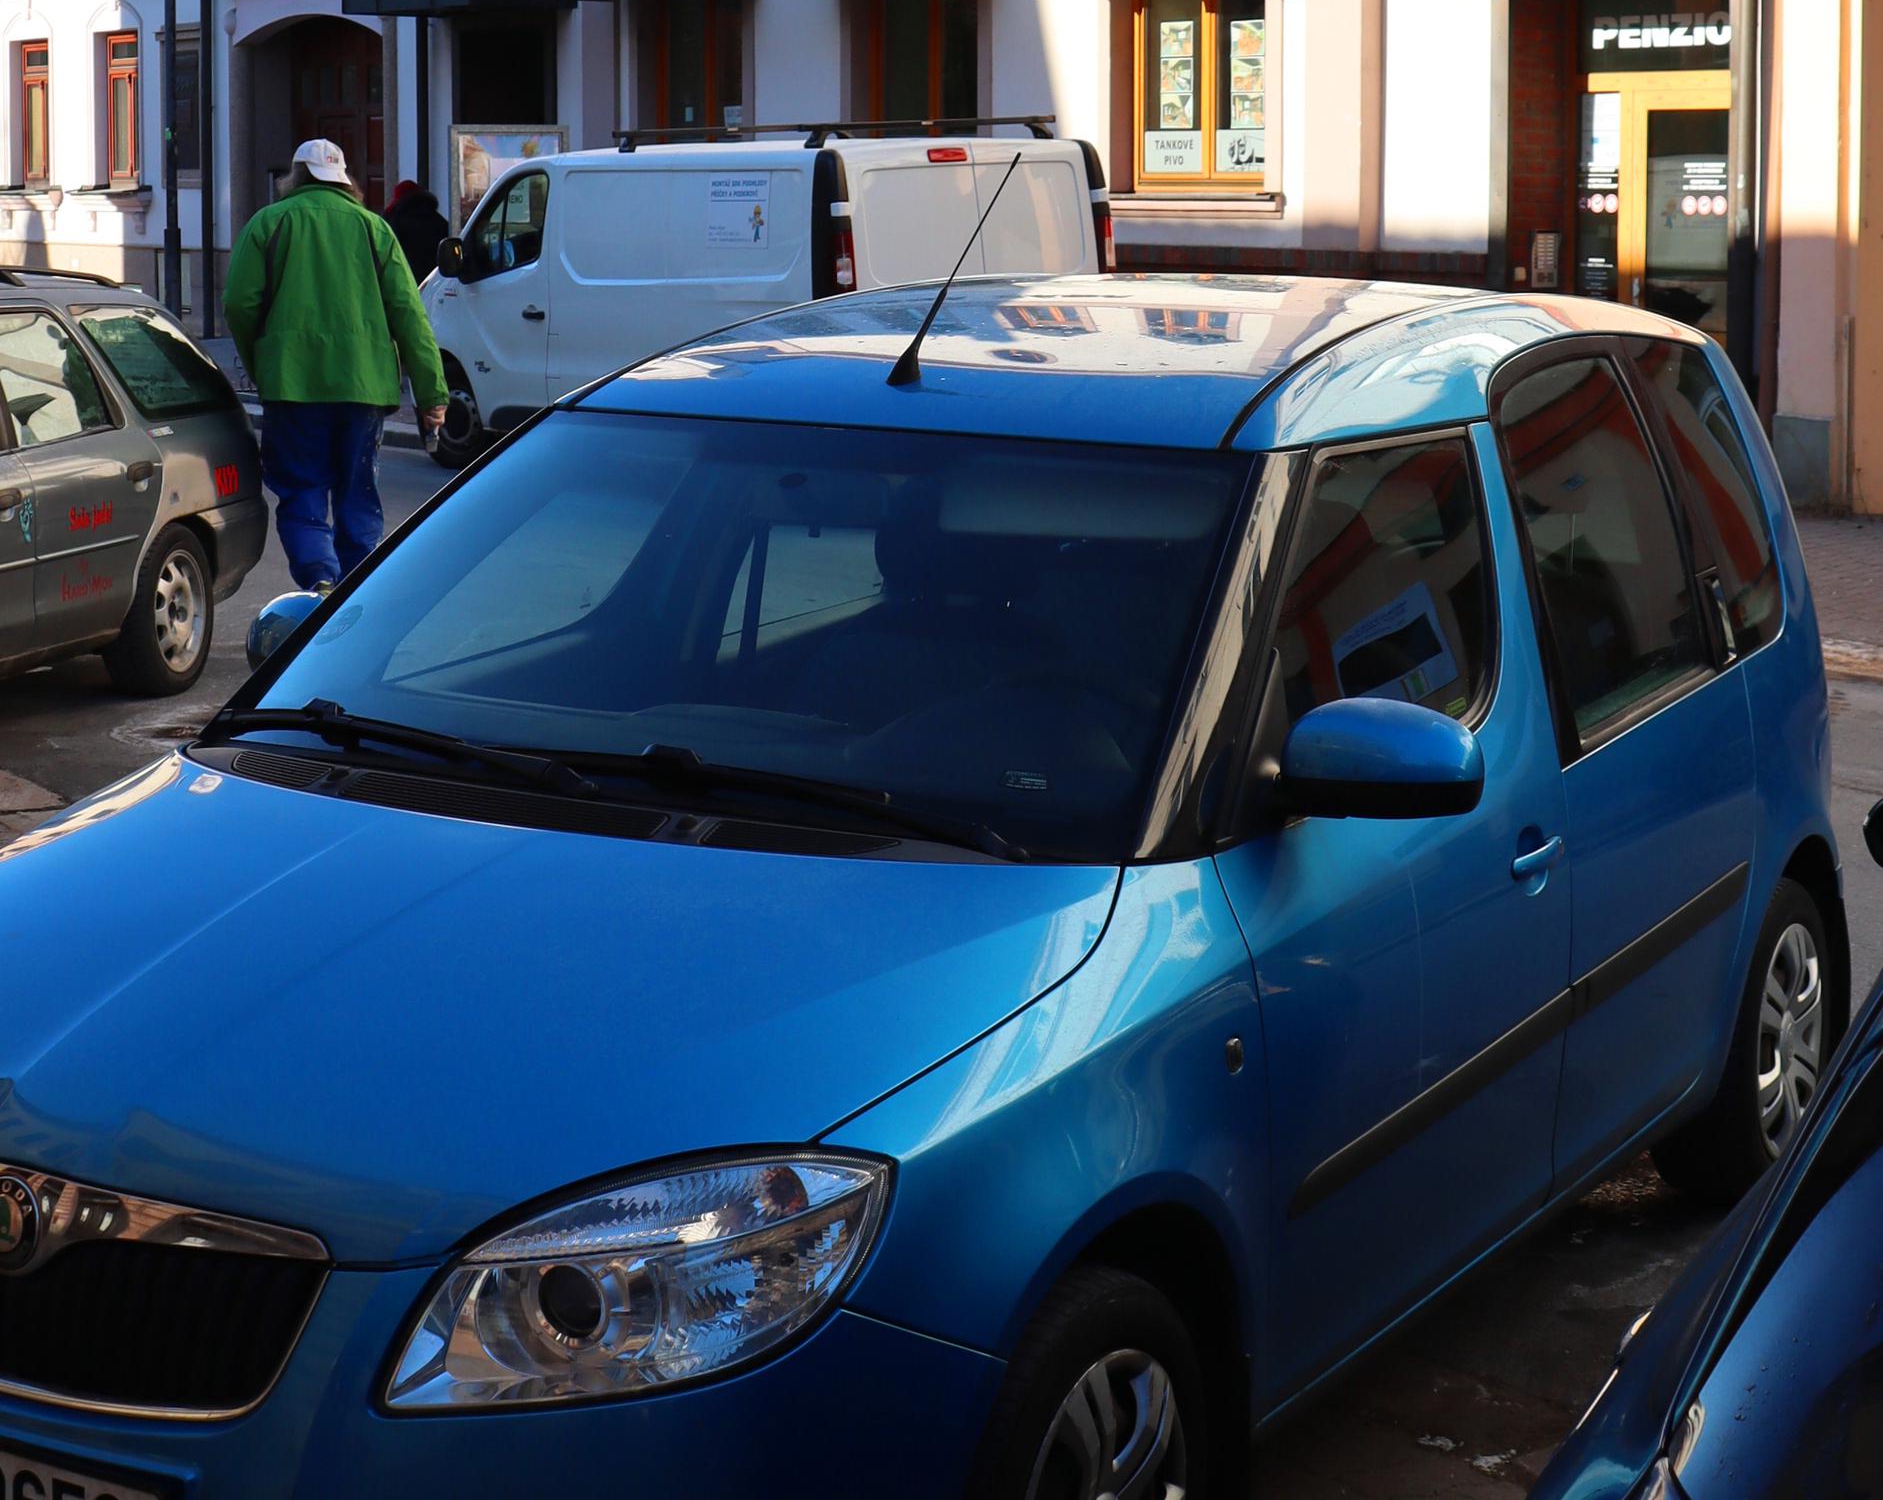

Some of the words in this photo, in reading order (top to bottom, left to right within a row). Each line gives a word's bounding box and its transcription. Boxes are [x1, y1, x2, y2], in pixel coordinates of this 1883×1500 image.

[1592, 11, 1733, 50] PENZIO
[1155, 138, 1194, 150] TANKOVÉ
[1164, 155, 1184, 166] PIVO
